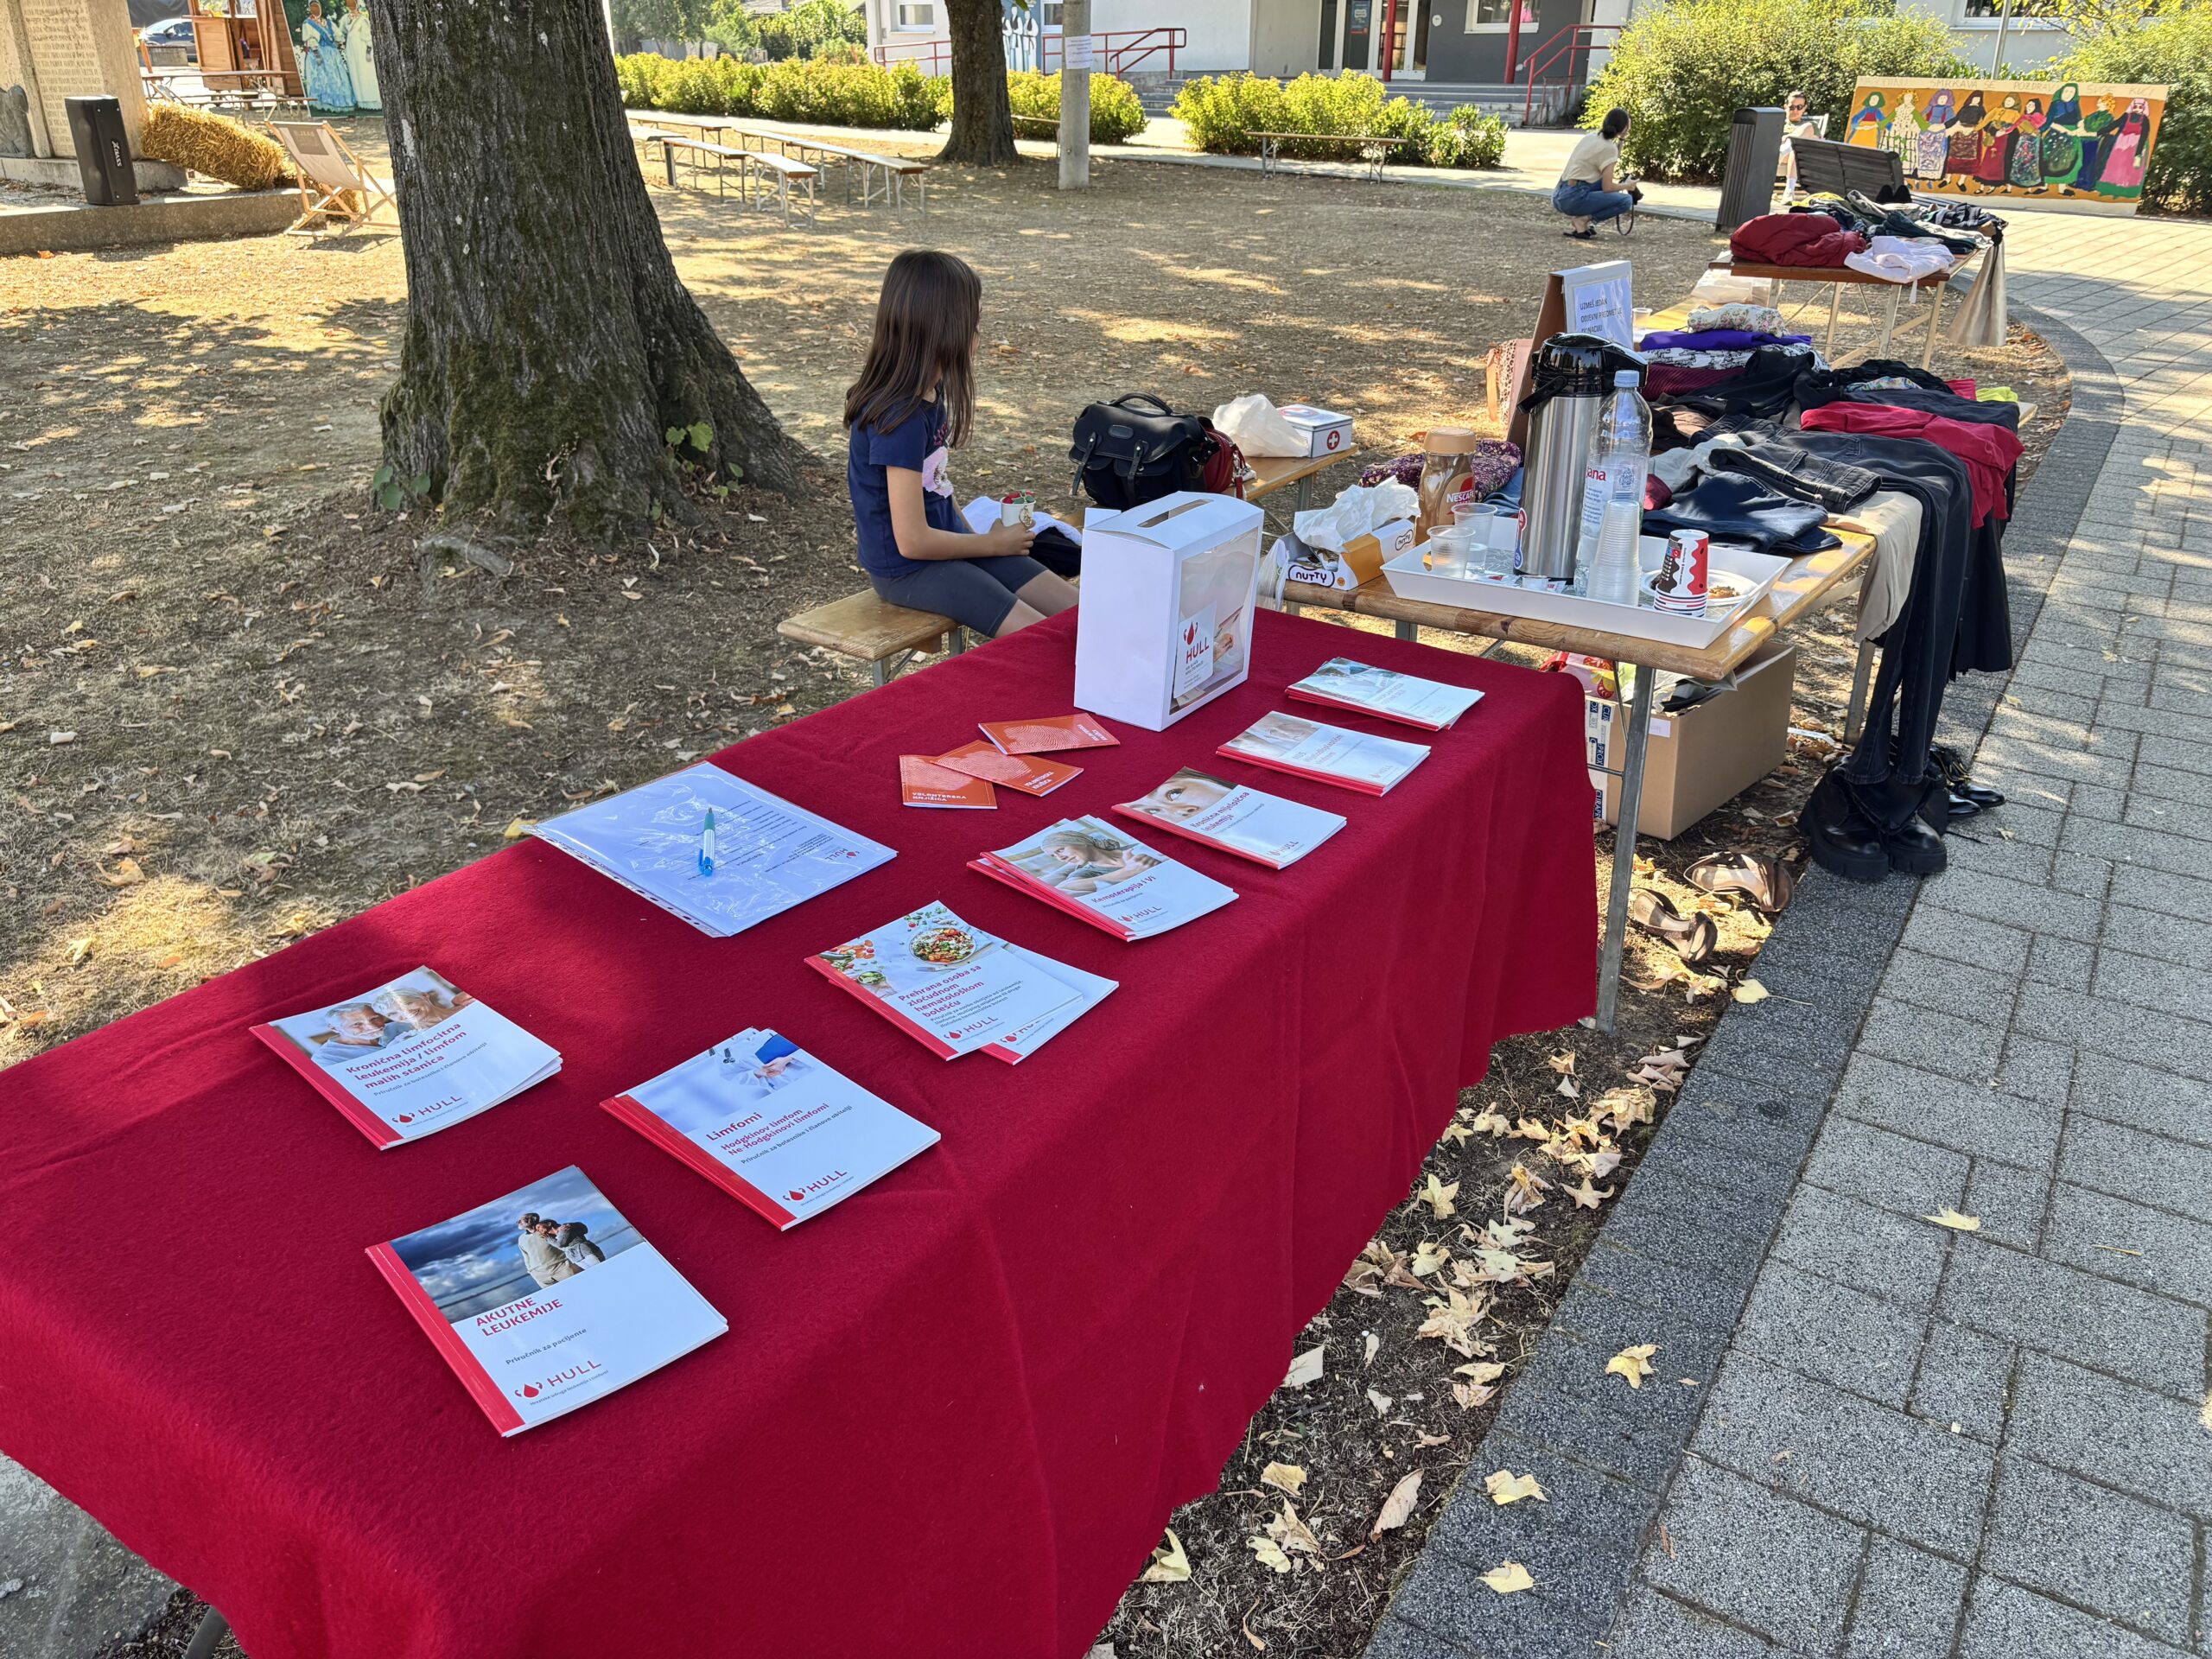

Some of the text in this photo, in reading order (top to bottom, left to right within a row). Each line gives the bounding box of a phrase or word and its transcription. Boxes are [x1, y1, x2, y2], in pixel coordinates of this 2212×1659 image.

[1185, 637, 1210, 664] HULL
[1281, 841, 1299, 853] HULL
[1091, 882, 1143, 903] Kemoterapija
[1133, 906, 1162, 918] HULL
[899, 982, 942, 1001] Prehrana
[943, 969, 970, 983] osoba
[907, 983, 959, 1007] zloćudnom
[913, 981, 984, 1012] hematološkom
[922, 1001, 961, 1017] bolešću
[963, 1017, 999, 1033] HULL
[346, 1023, 461, 1073] Kronična limfocitna
[354, 1057, 416, 1081] leukemija
[423, 1031, 467, 1056] limfom
[365, 1054, 445, 1089] malih stanica
[373, 1084, 402, 1096] Priručnik
[418, 1096, 462, 1116] HULL
[706, 1111, 763, 1141] Limfomi
[721, 1109, 803, 1151] Hodgkinov limfom
[728, 1103, 830, 1156] Ne-Hodgkinovi limfomi
[741, 1149, 770, 1164] Priručnik
[778, 1131, 806, 1147] bolesnike
[809, 1116, 831, 1131] članove
[831, 1105, 853, 1119] obitelji
[806, 1170, 848, 1192] HULL
[476, 1297, 537, 1327] AKUTNE
[482, 1299, 563, 1337] LEUKEMIJE
[505, 1347, 543, 1365] Priručnik
[552, 1328, 588, 1348] pacijente
[547, 1360, 601, 1387] HULL
